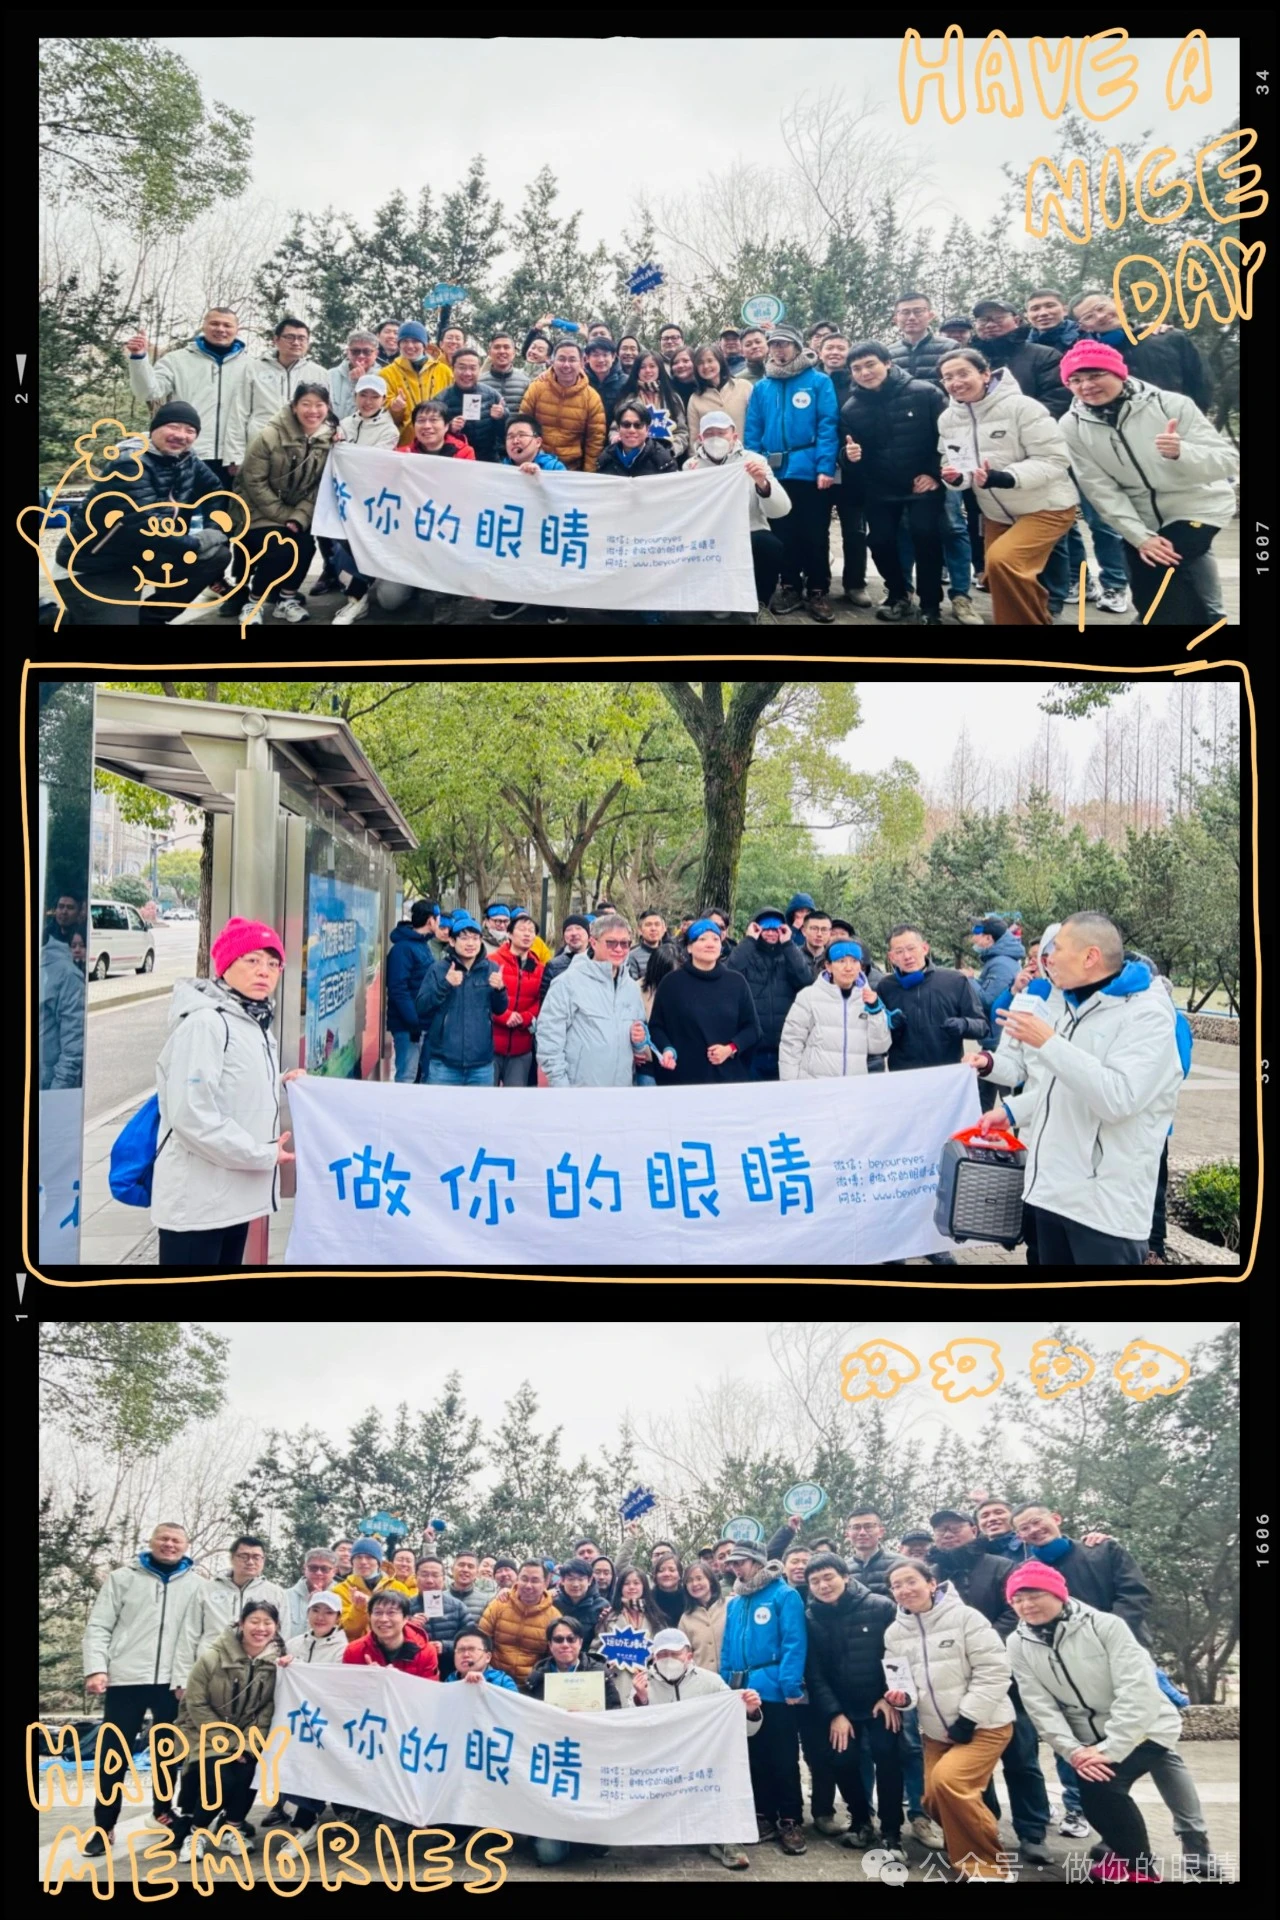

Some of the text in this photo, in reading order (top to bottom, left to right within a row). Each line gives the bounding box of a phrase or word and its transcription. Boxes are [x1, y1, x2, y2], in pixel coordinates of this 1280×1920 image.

[634, 535, 682, 544] beyoureyes
[632, 554, 722, 568] www.beyoureyes.org
[868, 1155, 924, 1168] beyoureyes
[327, 1130, 816, 1227] 做你的眼睛
[287, 1700, 583, 1801] 做你的眼睛
[629, 1765, 680, 1776] beyoureyes
[629, 1784, 721, 1800] www.beyoureyes.org
